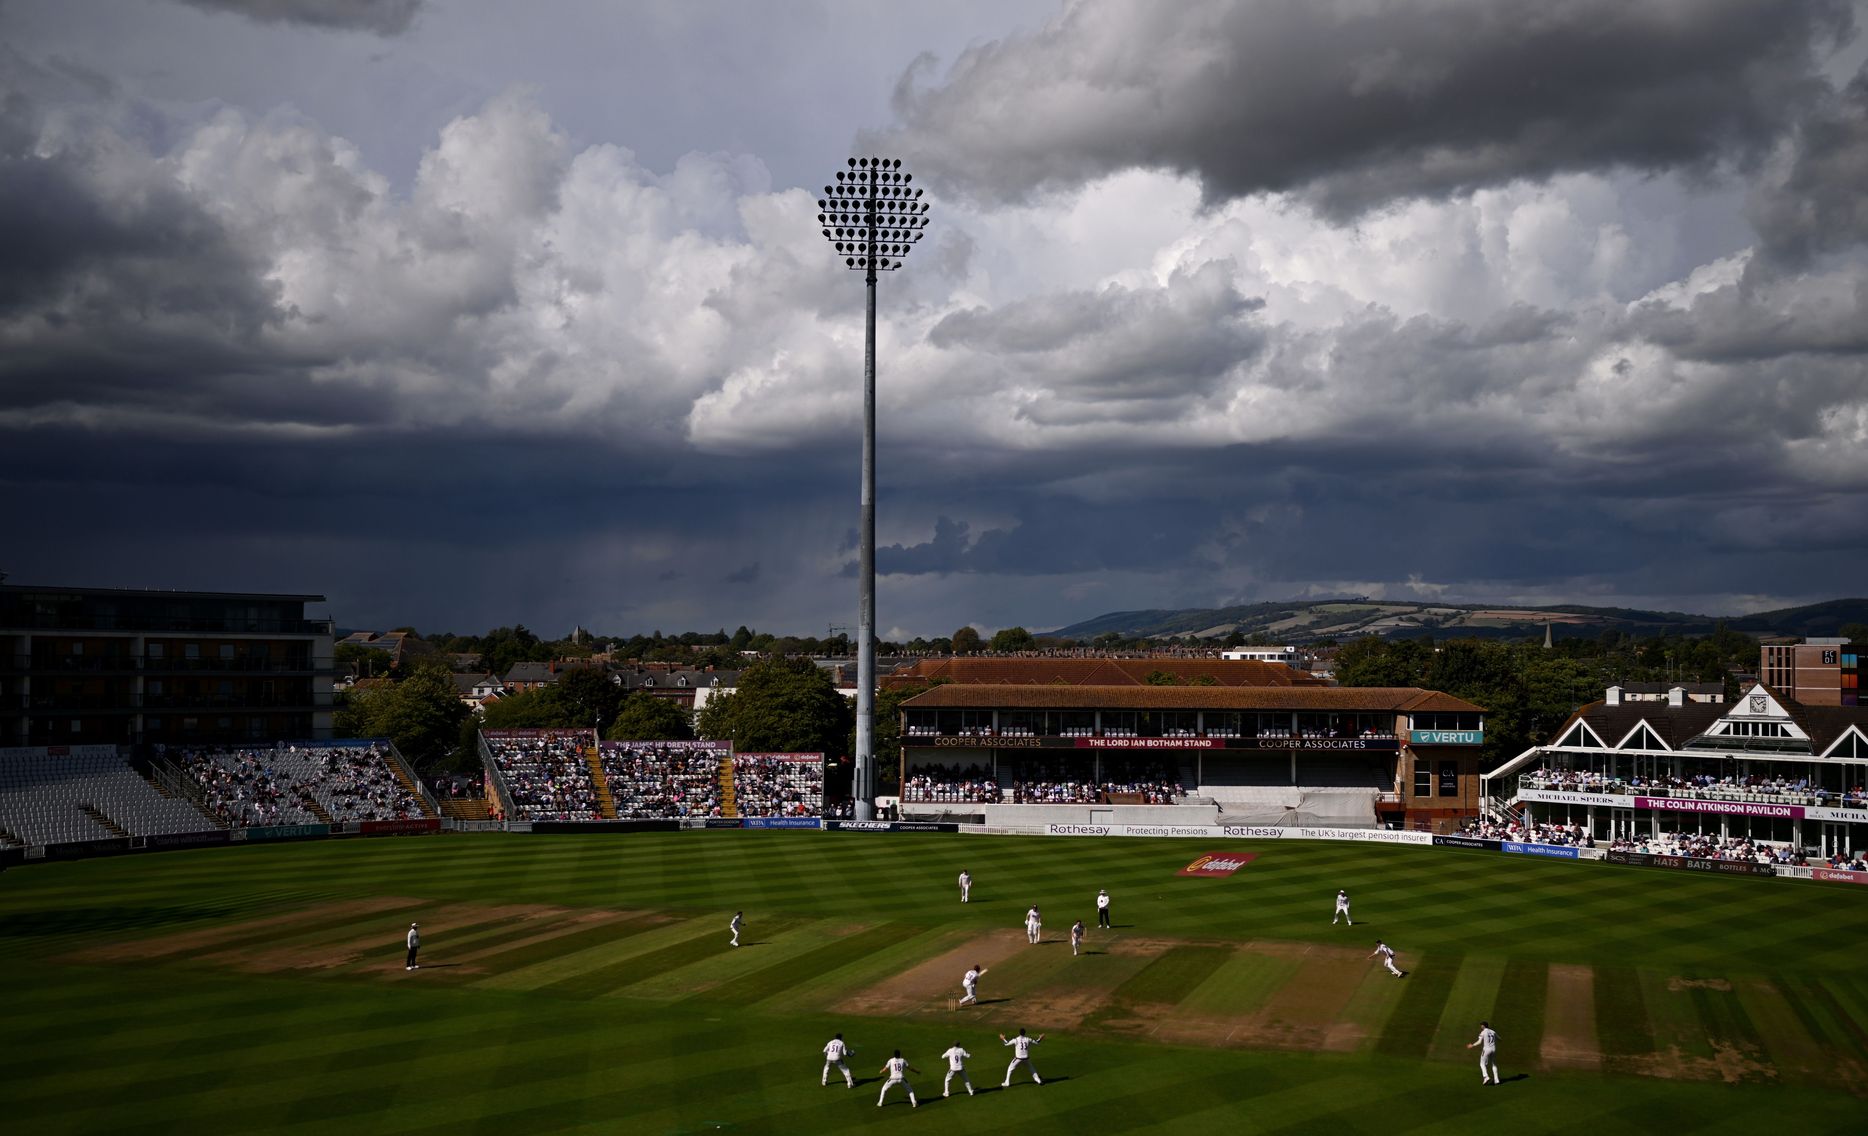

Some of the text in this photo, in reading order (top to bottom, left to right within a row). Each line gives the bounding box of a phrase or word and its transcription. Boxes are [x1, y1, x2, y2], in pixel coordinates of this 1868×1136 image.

[934, 737, 1041, 747] COOPER ASSOCIATES
[1432, 732, 1474, 742] VERTU
[1088, 739, 1212, 748] THE LORD IAN BOTHAM STAND
[1258, 740, 1366, 749] COOPER ASSOCIATES
[1537, 793, 1579, 802] MICHAEL
[1580, 795, 1614, 804] SPIERS
[1646, 799, 1791, 817] THE COLIN ATKINSON PAVILION
[838, 821, 891, 829] SKECHERS
[275, 826, 312, 836] VERTU
[1050, 824, 1110, 837] Rothesay
[1126, 826, 1208, 836] Protecting Pensions
[1223, 825, 1284, 838] Rothesay
[1300, 829, 1427, 842] The UK's largest pension insurer
[1527, 846, 1573, 856] Health Insurance
[1653, 857, 1679, 867] HATS
[1686, 859, 1712, 870] BATS
[1719, 863, 1747, 872] BOTTLES
[831, 1045, 839, 1053] 51
[1020, 1041, 1028, 1050] 33
[954, 1055, 960, 1063] 9
[894, 1062, 902, 1072] 18
